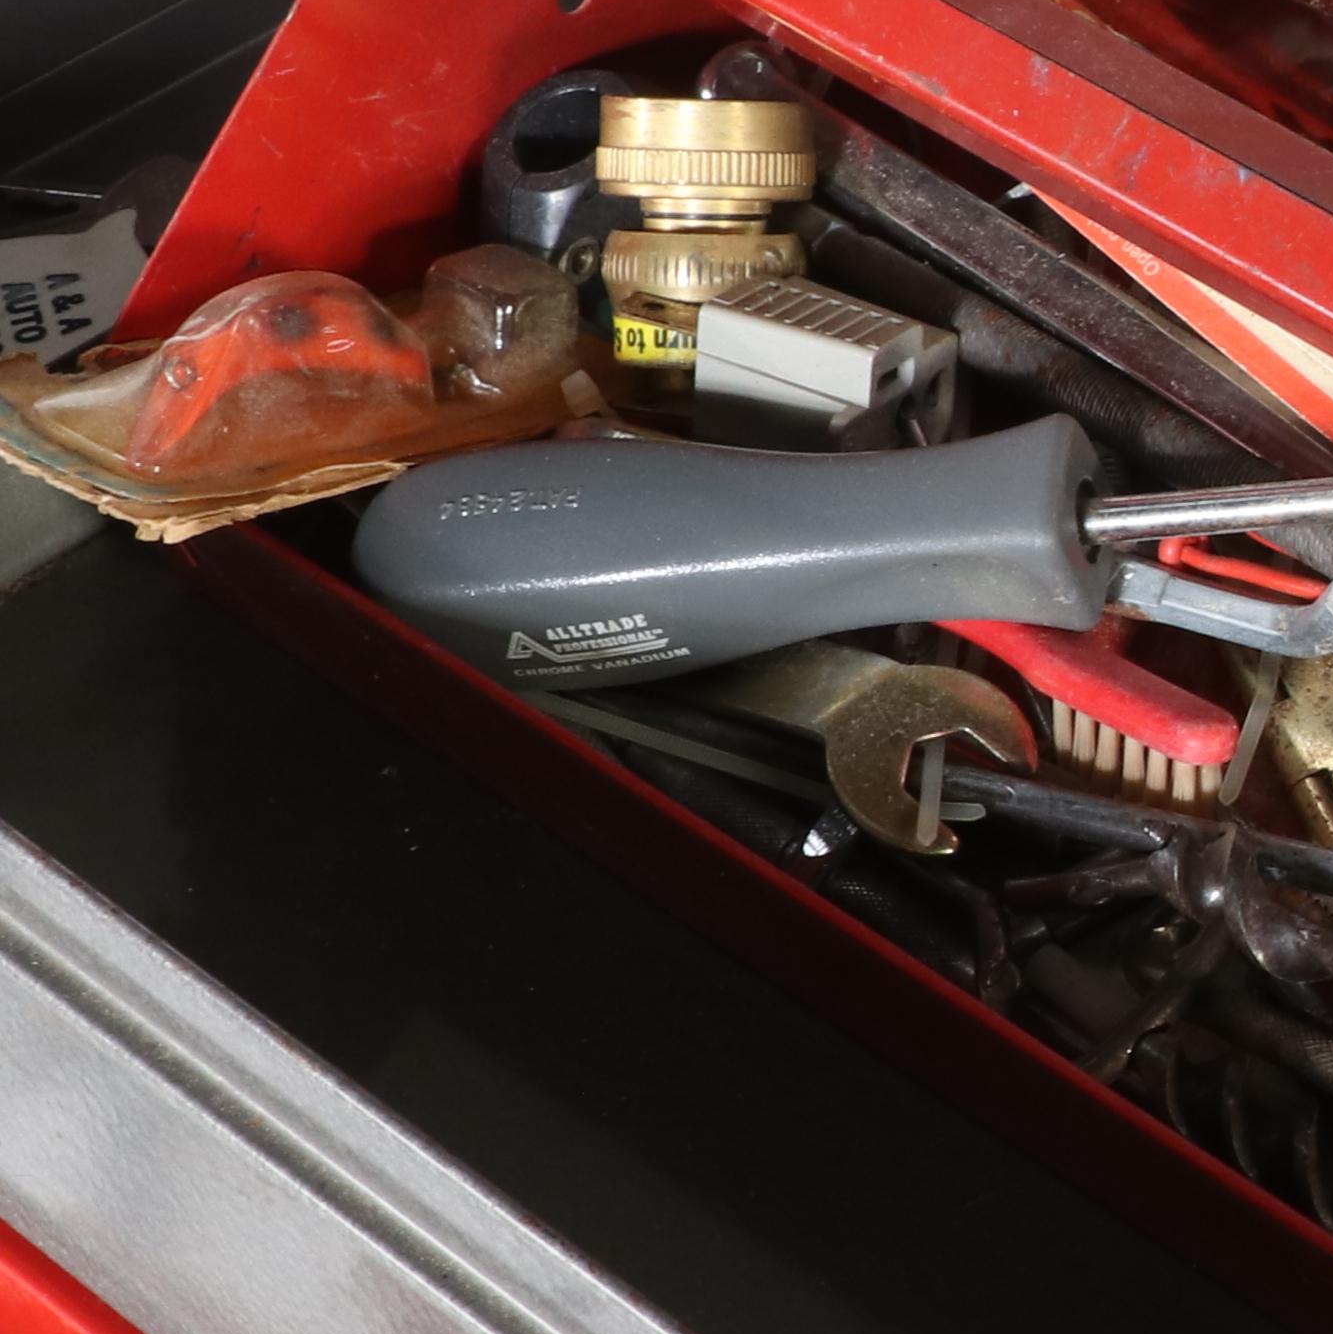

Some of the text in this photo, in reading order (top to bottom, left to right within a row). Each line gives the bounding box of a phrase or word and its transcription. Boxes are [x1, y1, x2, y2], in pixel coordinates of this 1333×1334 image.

[0, 283, 47, 344] AUTO
[58, 317, 92, 336] A
[626, 328, 646, 354] to
[546, 613, 647, 641] ALLTRADE
[513, 646, 691, 677] CHROME VANADIUM
